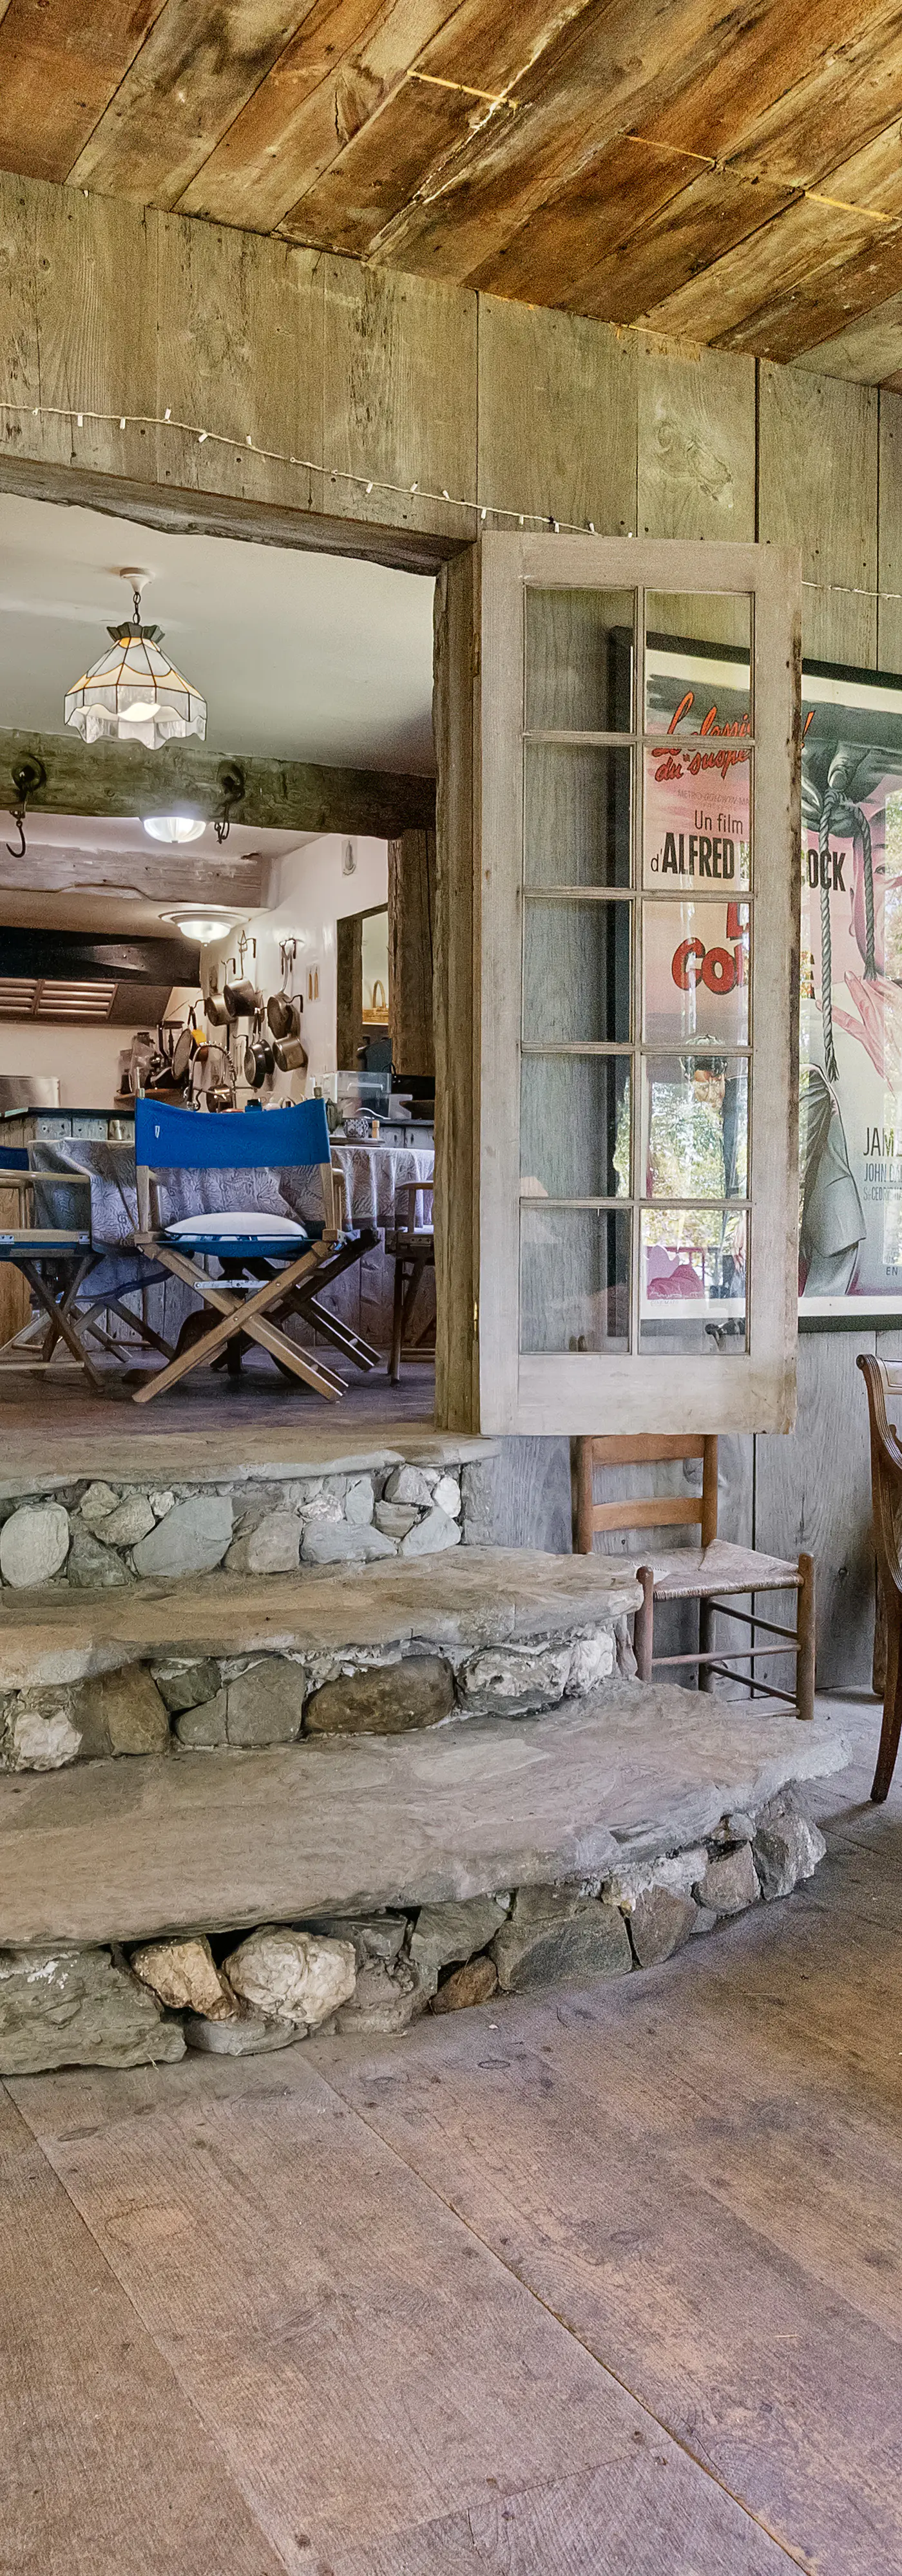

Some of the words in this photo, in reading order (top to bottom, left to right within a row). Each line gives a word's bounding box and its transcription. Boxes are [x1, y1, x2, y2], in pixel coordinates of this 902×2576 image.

[655, 755, 684, 782] du
[683, 749, 749, 781] "suspe
[695, 810, 712, 831] Un
[716, 813, 743, 834] film
[651, 832, 734, 879] d'ALFRED
[807, 849, 847, 892] OCK
[726, 902, 750, 941] L
[863, 1127, 902, 1157] JAME
[864, 1163, 887, 1182] JOHN
[886, 1267, 898, 1276] EN
